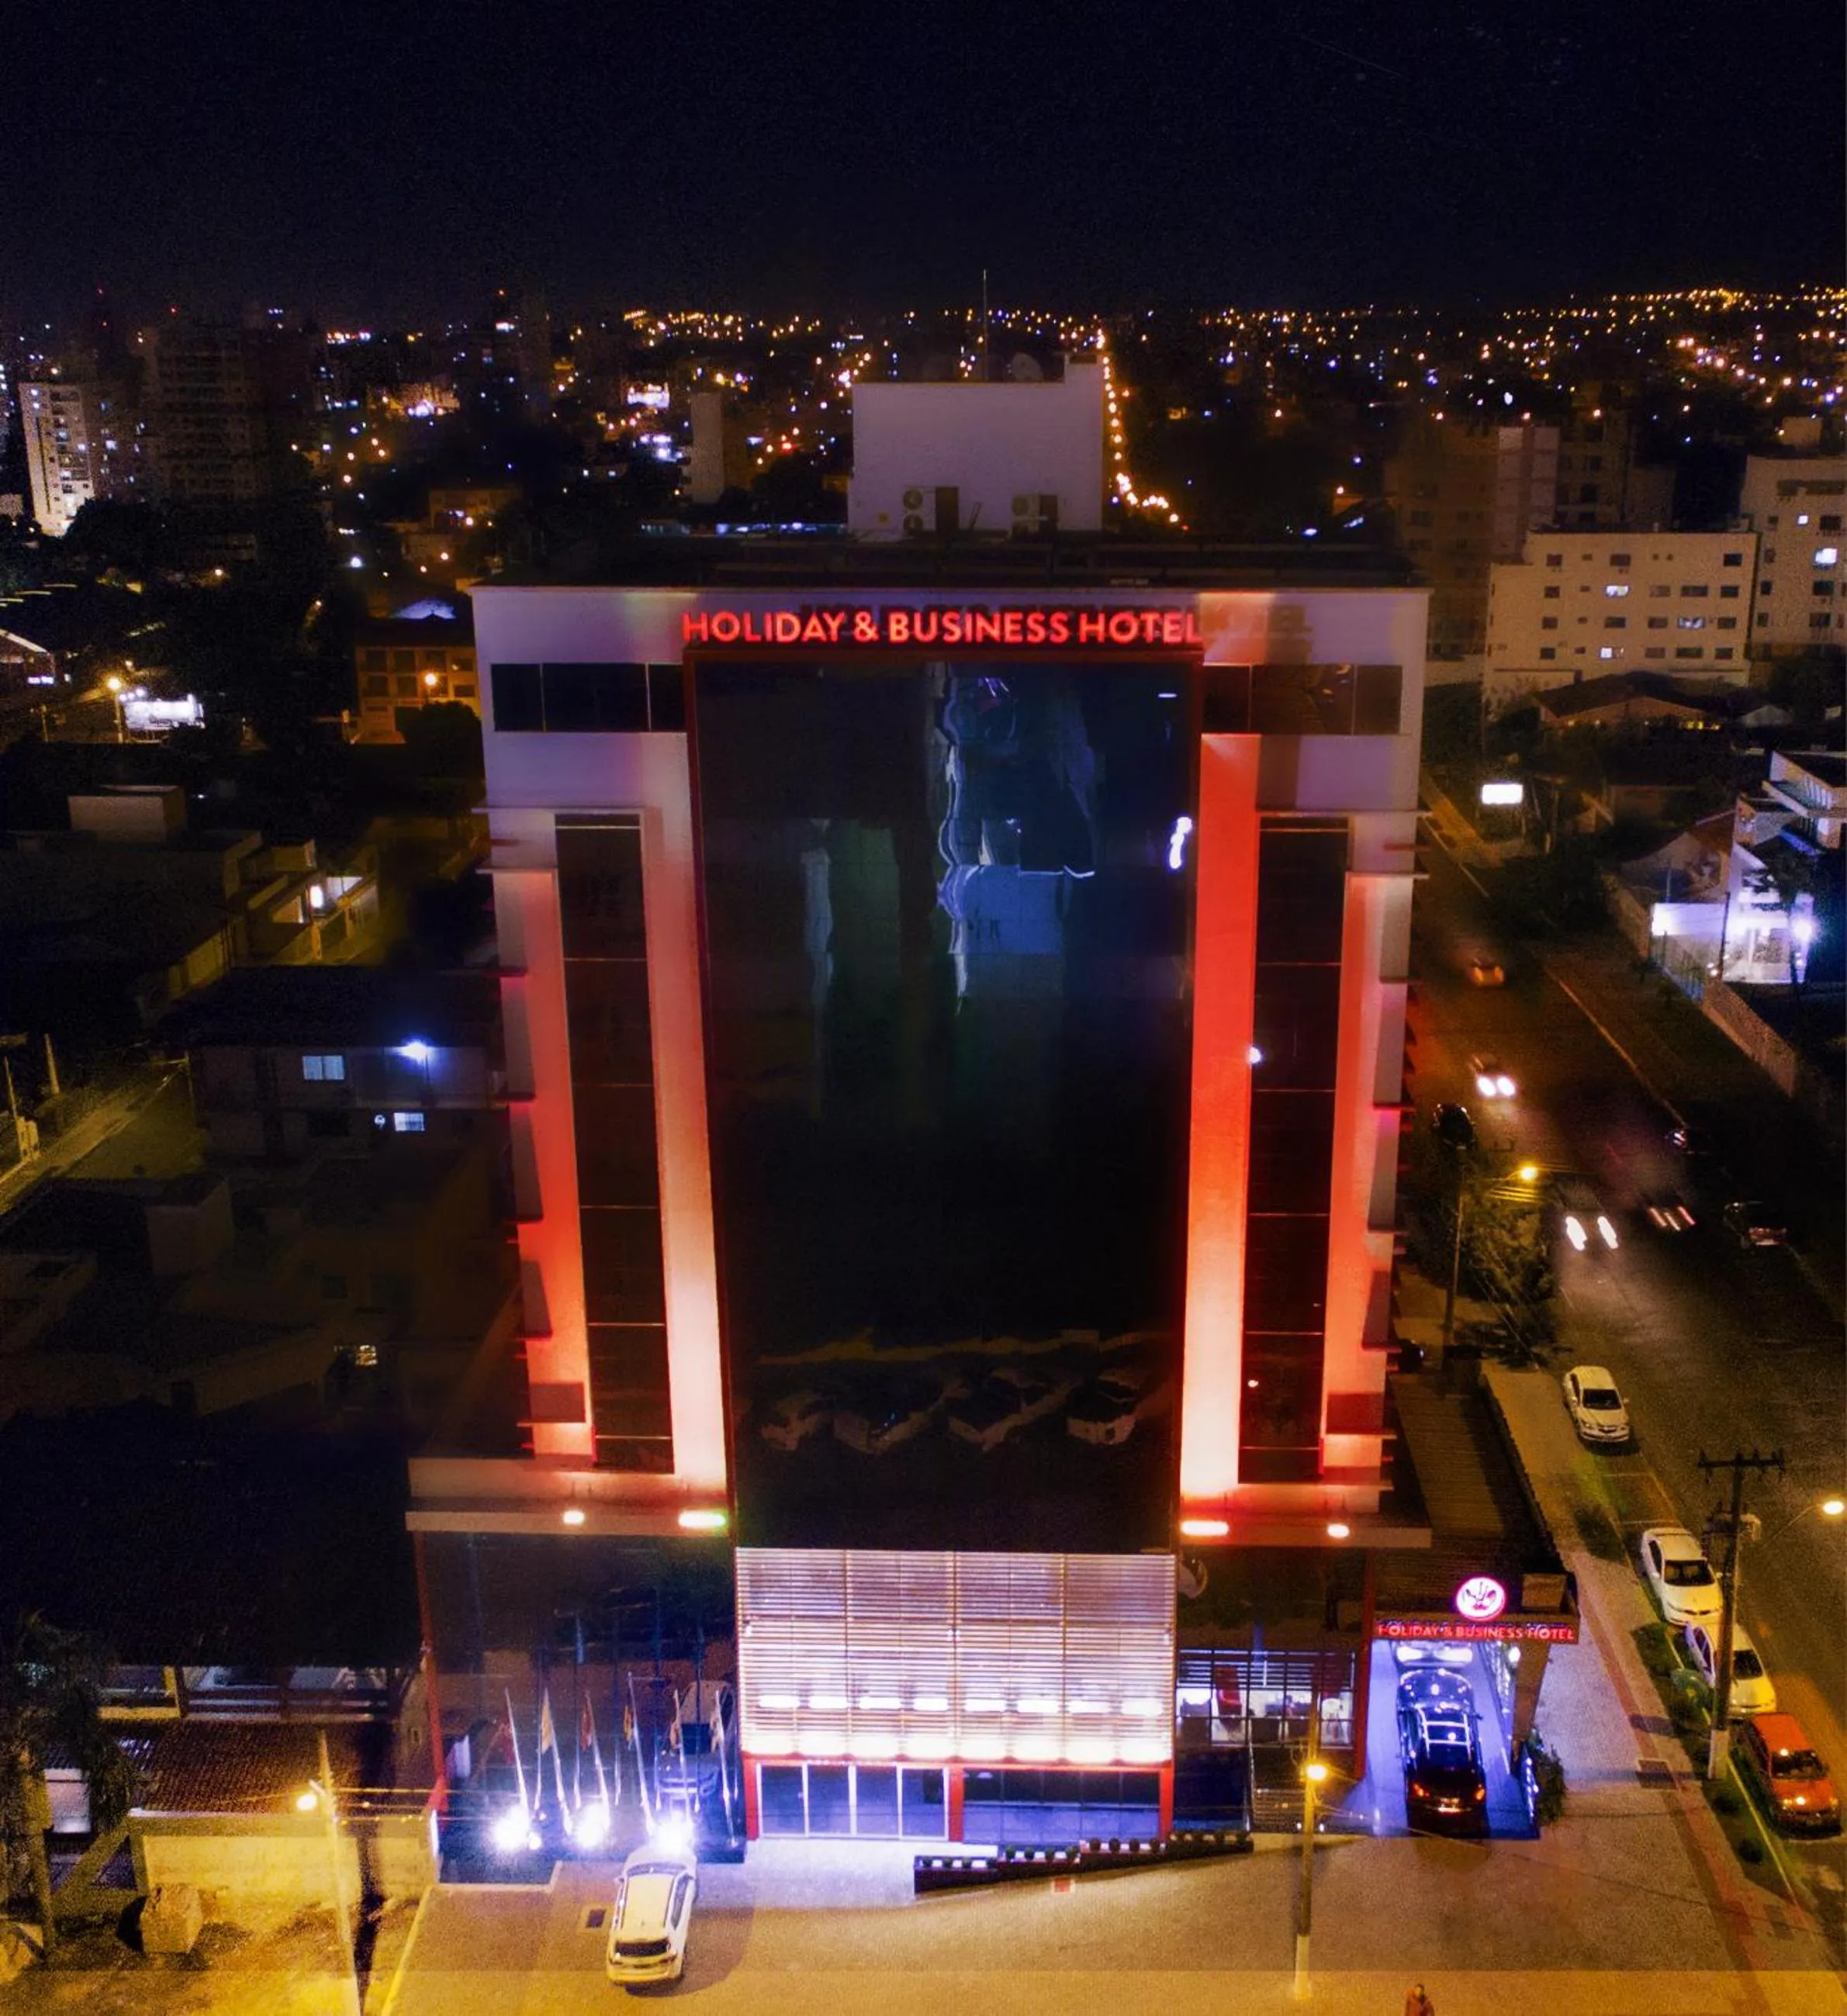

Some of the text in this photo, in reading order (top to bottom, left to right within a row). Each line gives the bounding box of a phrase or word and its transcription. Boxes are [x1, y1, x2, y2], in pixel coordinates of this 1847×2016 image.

[681, 610, 1202, 644] HOLIDAY & BUSINESS HOTEL
[1378, 1624, 1438, 1637] HOLIDAY
[1454, 1626, 1524, 1639] BUSINESS
[1526, 1627, 1575, 1640] HOTEL
